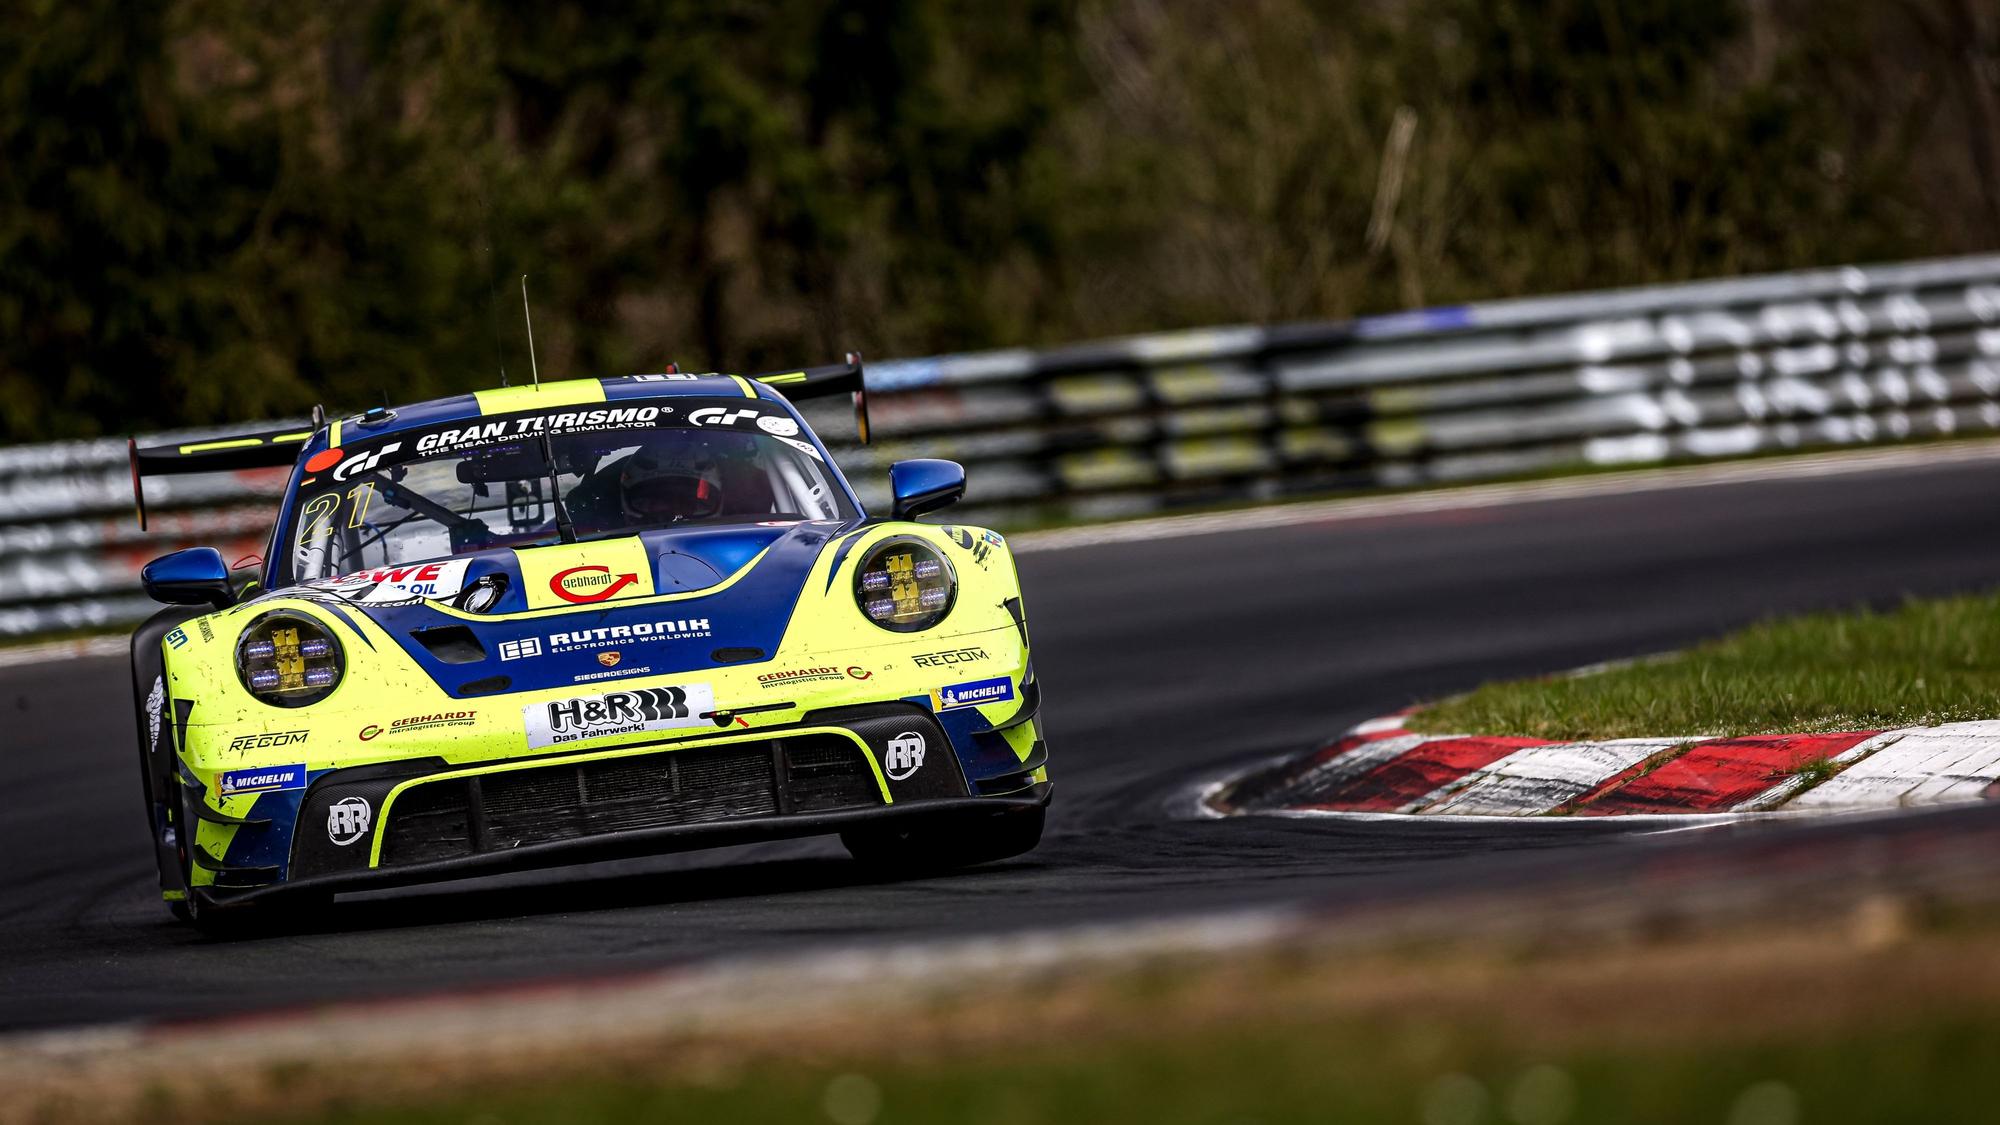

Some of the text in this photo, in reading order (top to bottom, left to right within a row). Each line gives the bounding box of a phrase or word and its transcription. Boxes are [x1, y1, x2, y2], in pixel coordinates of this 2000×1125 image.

[416, 407, 659, 451] GRAN TURISMO
[418, 421, 657, 457] THE REAL DRIVING SIMULATOR
[299, 481, 375, 546] 21
[410, 583, 437, 595] OIL
[563, 573, 612, 589] gebhardt
[549, 618, 710, 646] RUTRONIK
[552, 631, 712, 653] ELECTRONICS WORLDWIDE
[911, 647, 990, 668] RECOM
[574, 666, 650, 682] SIEGERDESIGNS
[757, 667, 839, 682] GEBHARDT
[761, 677, 817, 689] Intralogistics
[958, 685, 1007, 700] MICHELIN
[391, 710, 477, 727] GEBHARDT
[548, 693, 642, 733] H&R
[389, 723, 444, 735] Intralogistics
[553, 723, 645, 744] Das Fahrwerk!
[229, 730, 310, 751] RECOM
[887, 737, 923, 769] RR
[236, 772, 294, 788] MICHELIN
[329, 803, 369, 834] RR
